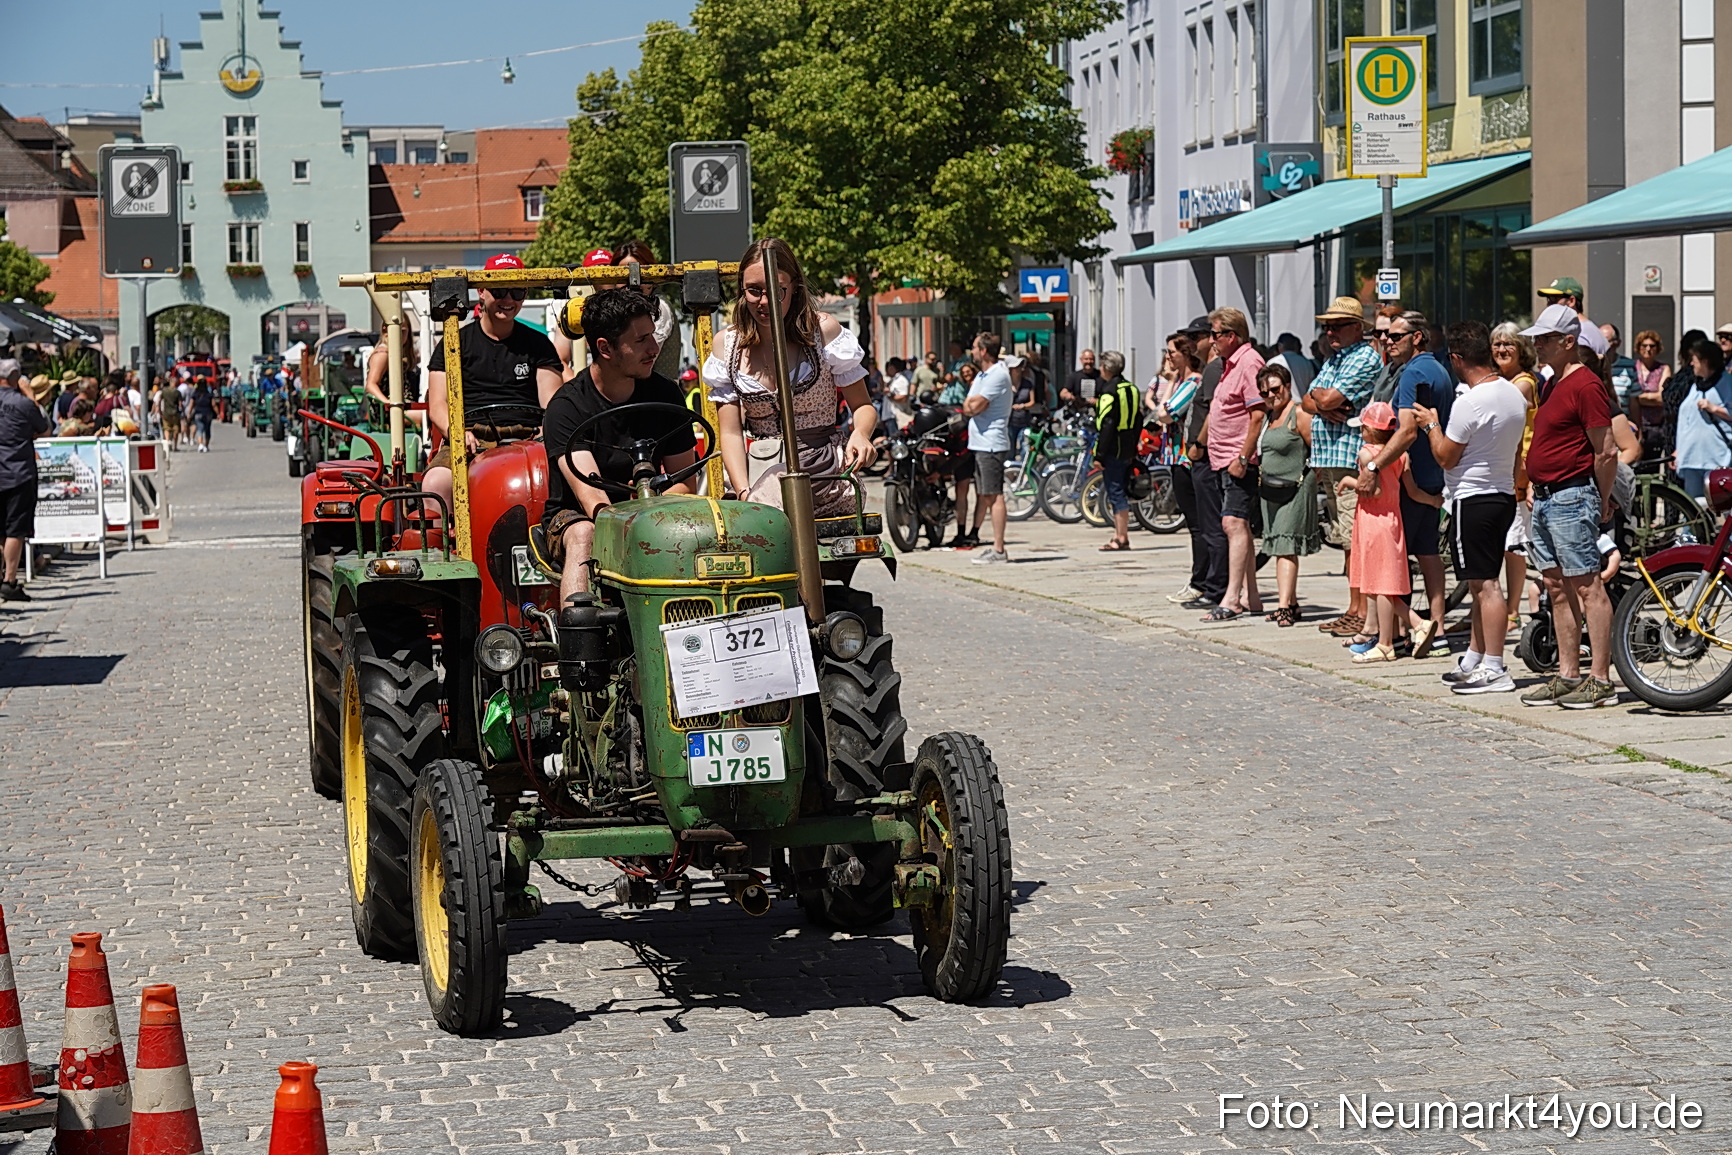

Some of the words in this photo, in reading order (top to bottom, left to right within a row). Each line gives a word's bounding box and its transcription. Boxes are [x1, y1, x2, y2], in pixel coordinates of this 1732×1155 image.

[1374, 60, 1398, 92] H
[1367, 112, 1406, 121] Rathaus
[1279, 161, 1304, 191] G2
[126, 202, 155, 212] ZONE
[697, 198, 726, 209] ZONE
[725, 628, 766, 652] 372
[694, 748, 701, 756] D
[708, 734, 723, 757] N
